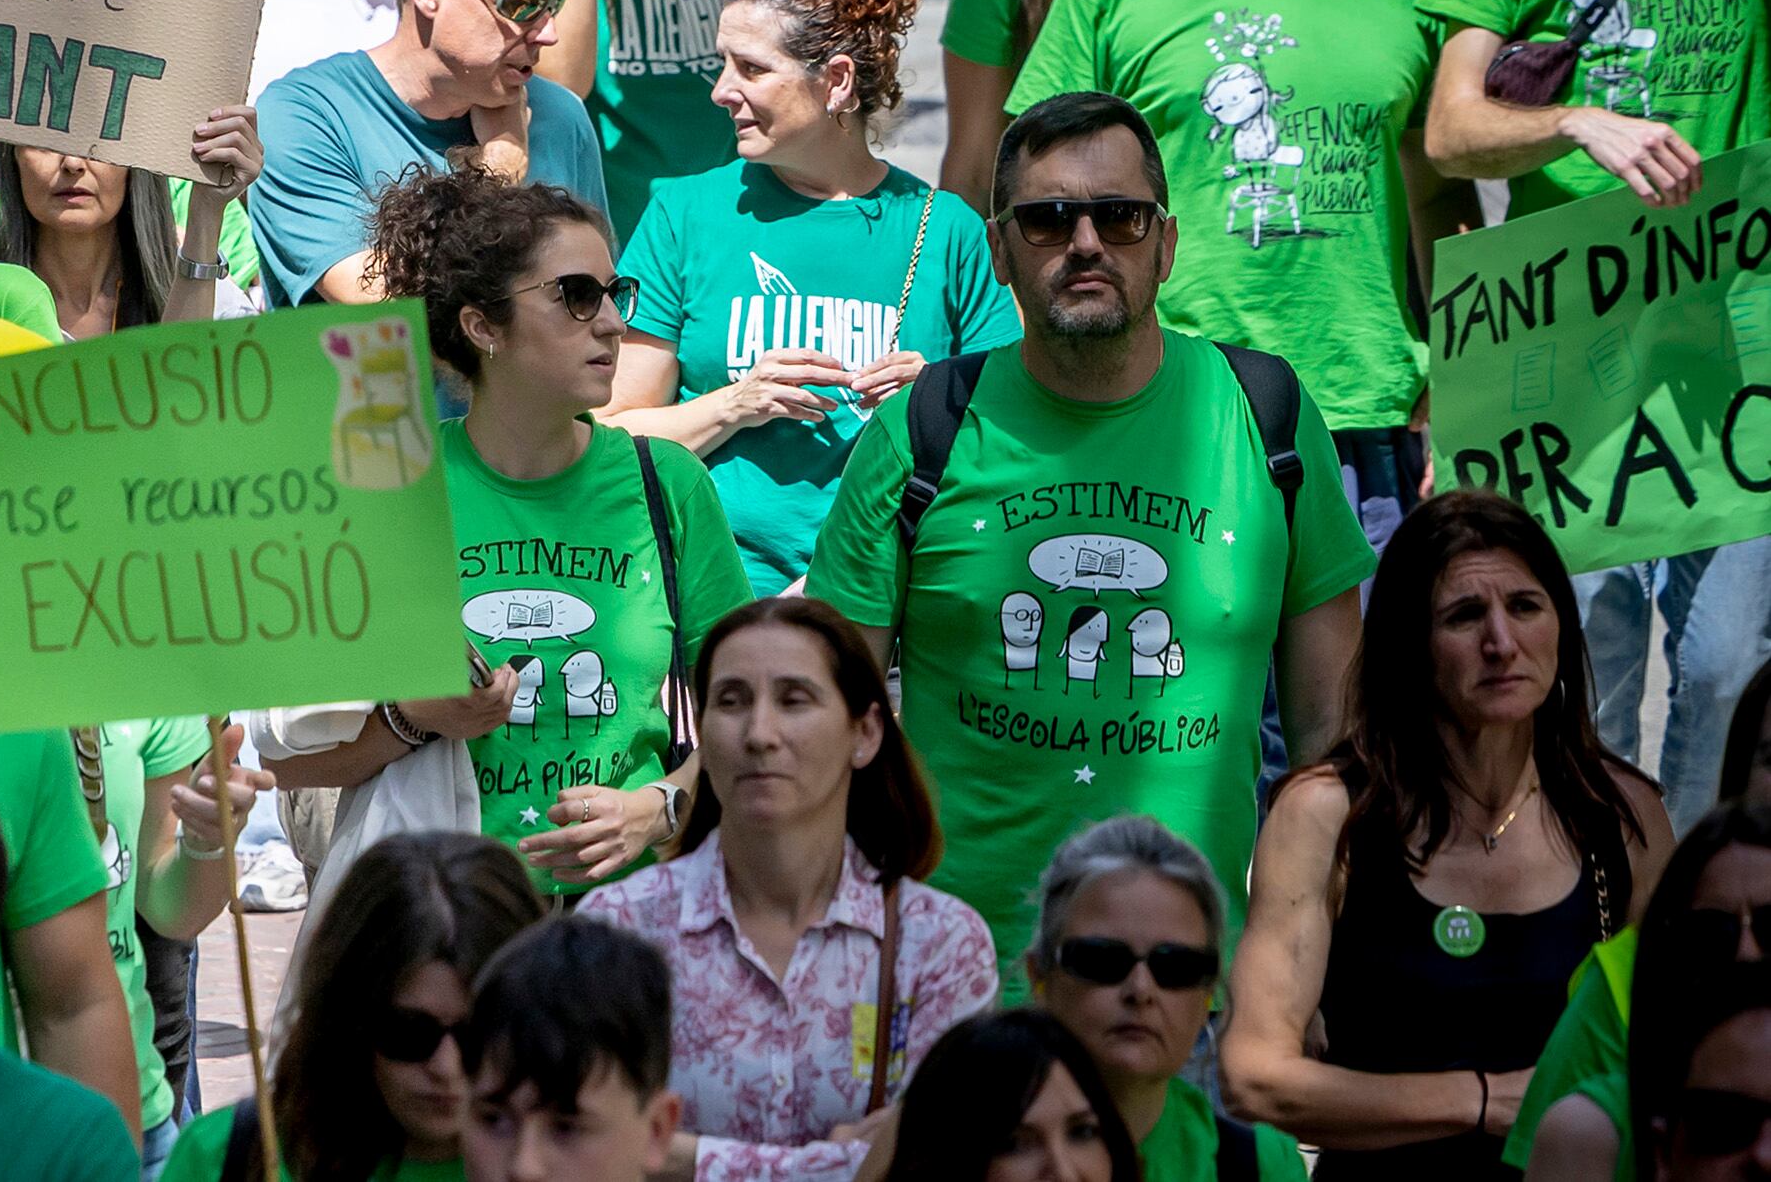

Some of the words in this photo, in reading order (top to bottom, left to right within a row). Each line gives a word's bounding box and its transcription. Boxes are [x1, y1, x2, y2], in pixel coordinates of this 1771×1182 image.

[684, 56, 726, 74] TO
[726, 294, 765, 368] LA
[1431, 247, 1569, 361] TANT
[120, 464, 340, 527] recursos
[1604, 403, 1699, 527] A
[996, 481, 1213, 545] ESTIMEM
